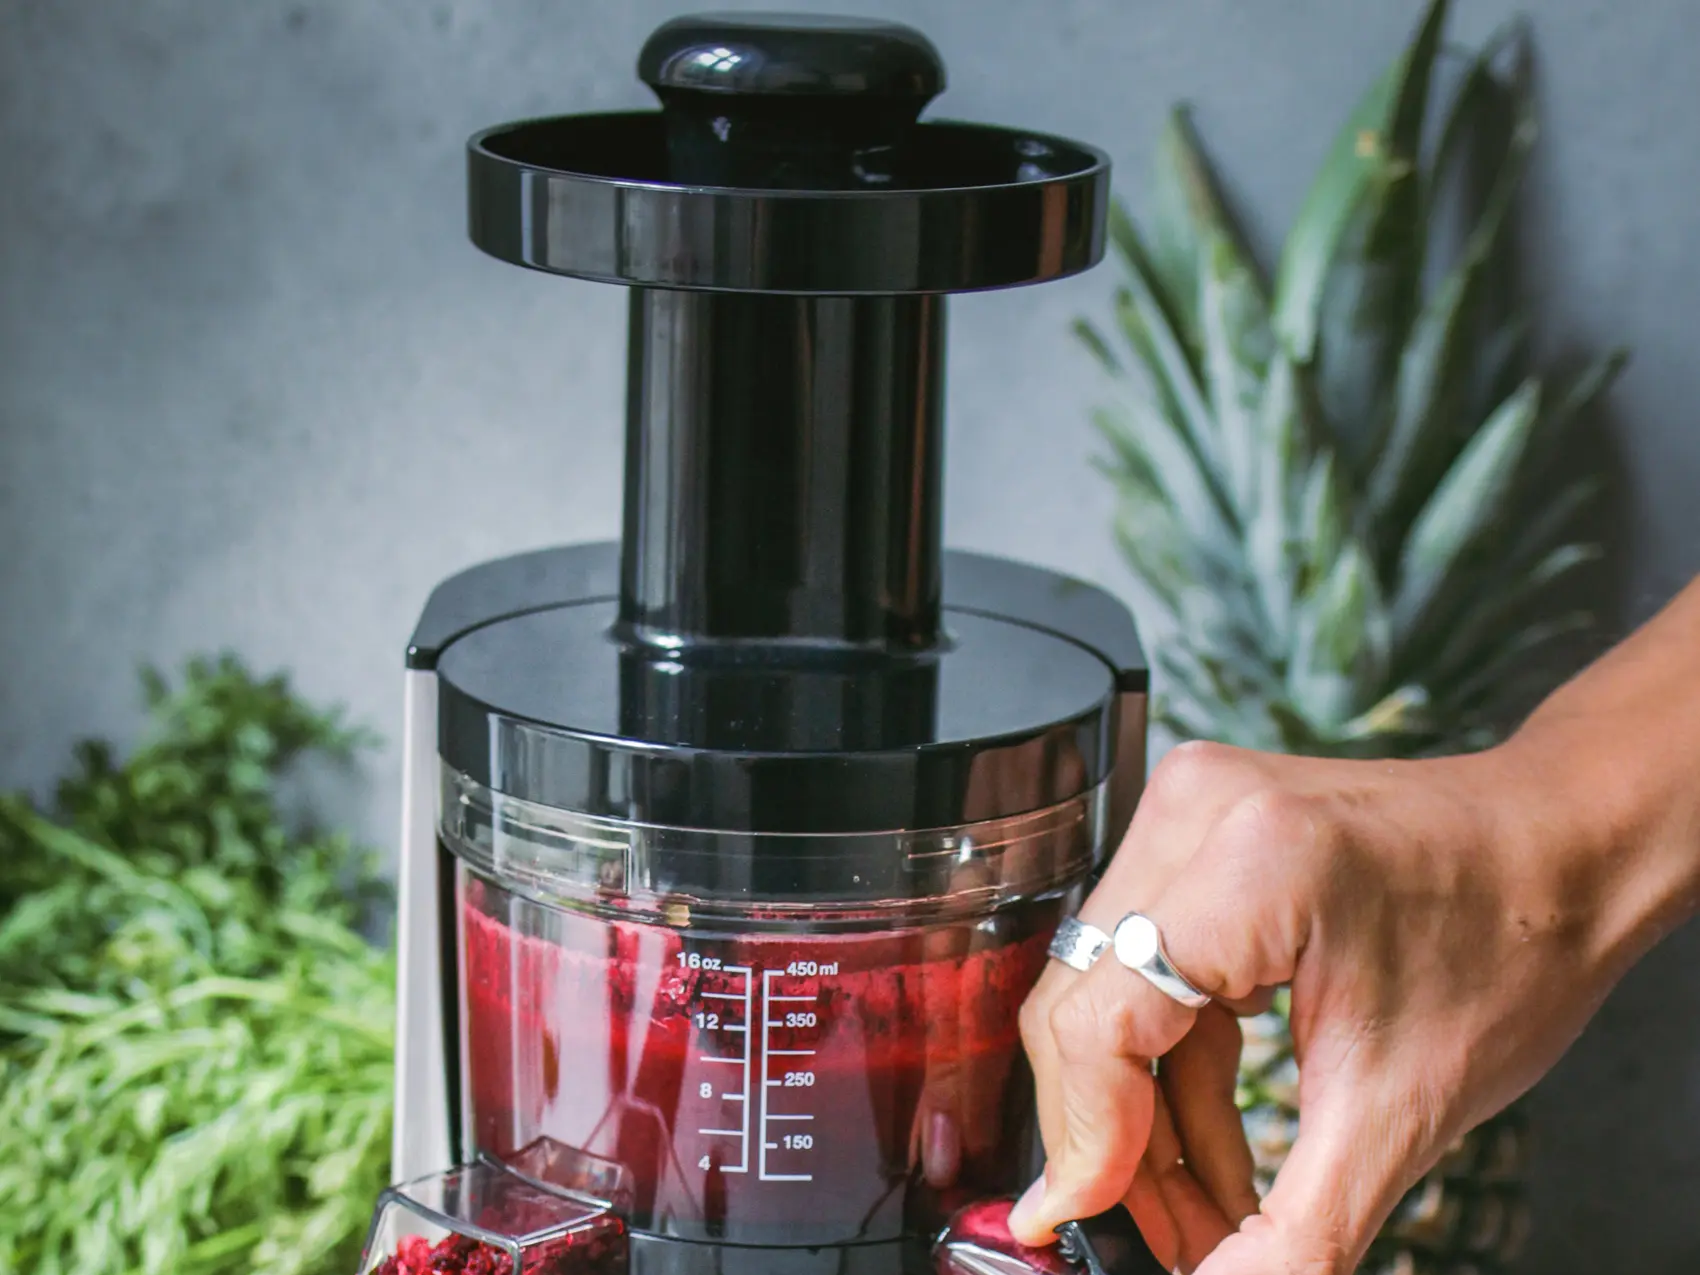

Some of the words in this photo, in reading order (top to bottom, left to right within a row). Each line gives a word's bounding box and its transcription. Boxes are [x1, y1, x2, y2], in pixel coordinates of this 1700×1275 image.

[696, 1013, 719, 1029] 12
[786, 1013, 817, 1027] 350
[784, 1072, 815, 1086] 250
[699, 1083, 712, 1098] 8
[783, 1135, 814, 1149] 150
[698, 1155, 711, 1171] 4
